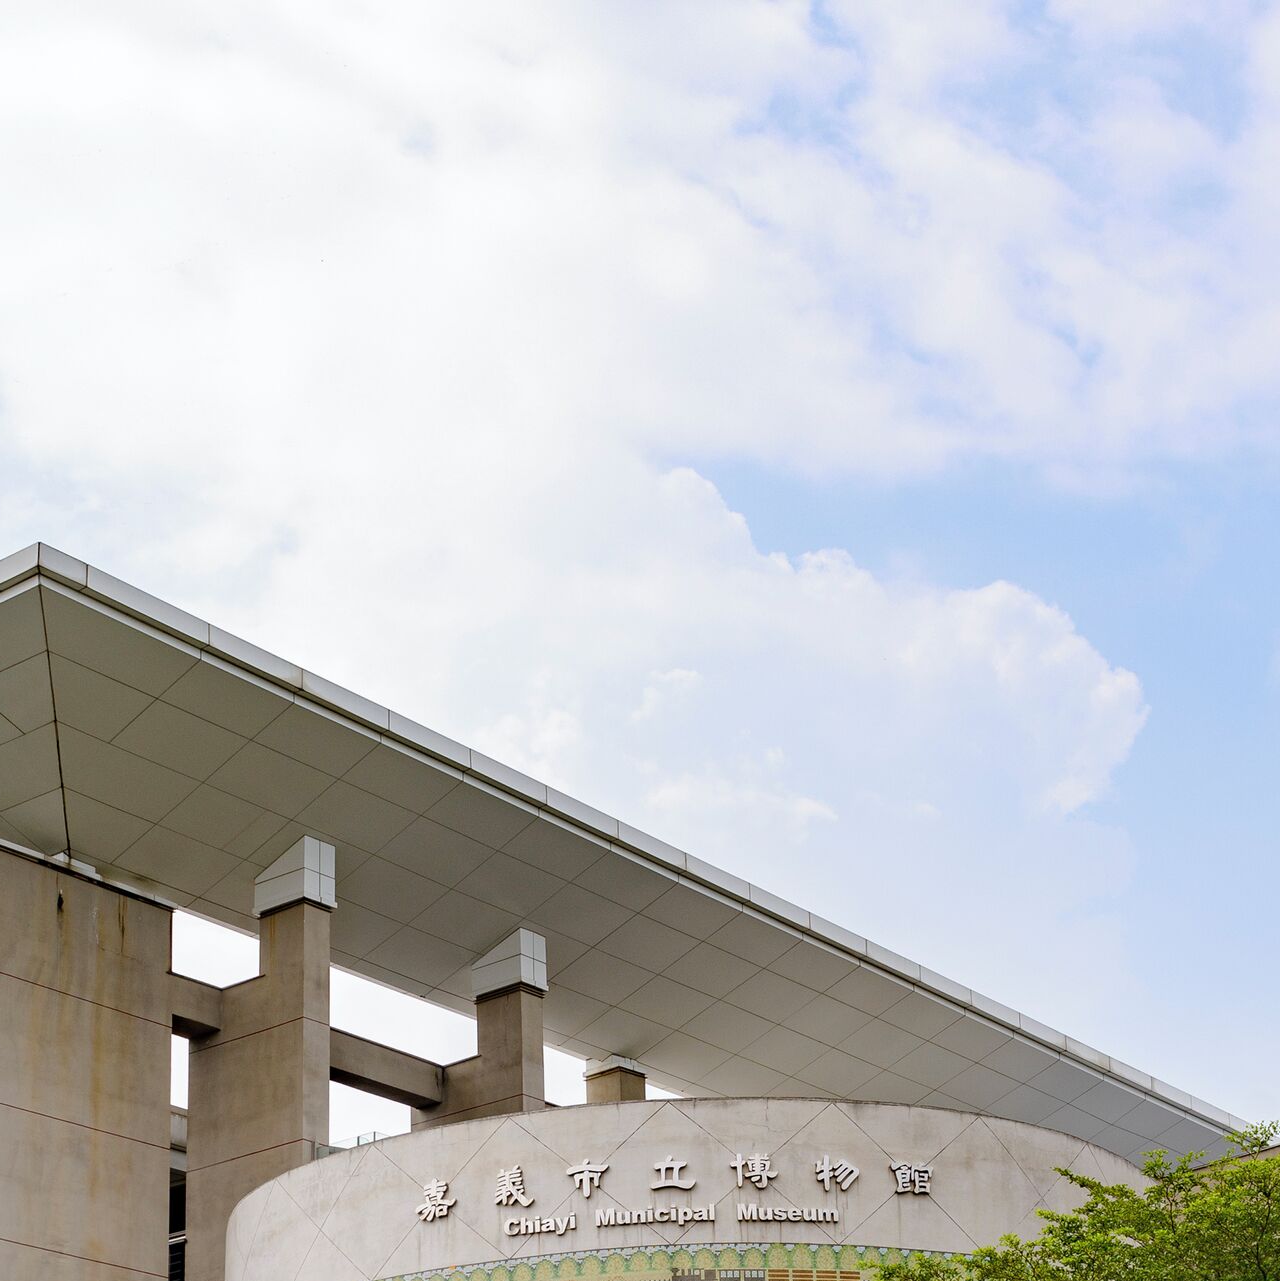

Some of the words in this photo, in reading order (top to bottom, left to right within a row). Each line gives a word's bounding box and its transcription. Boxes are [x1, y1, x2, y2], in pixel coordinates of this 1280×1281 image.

[415, 1152, 934, 1222] 嘉義市立博物館
[503, 1211, 577, 1236] Chiayi
[595, 1203, 716, 1228] Municipal
[737, 1203, 839, 1223] Museum
